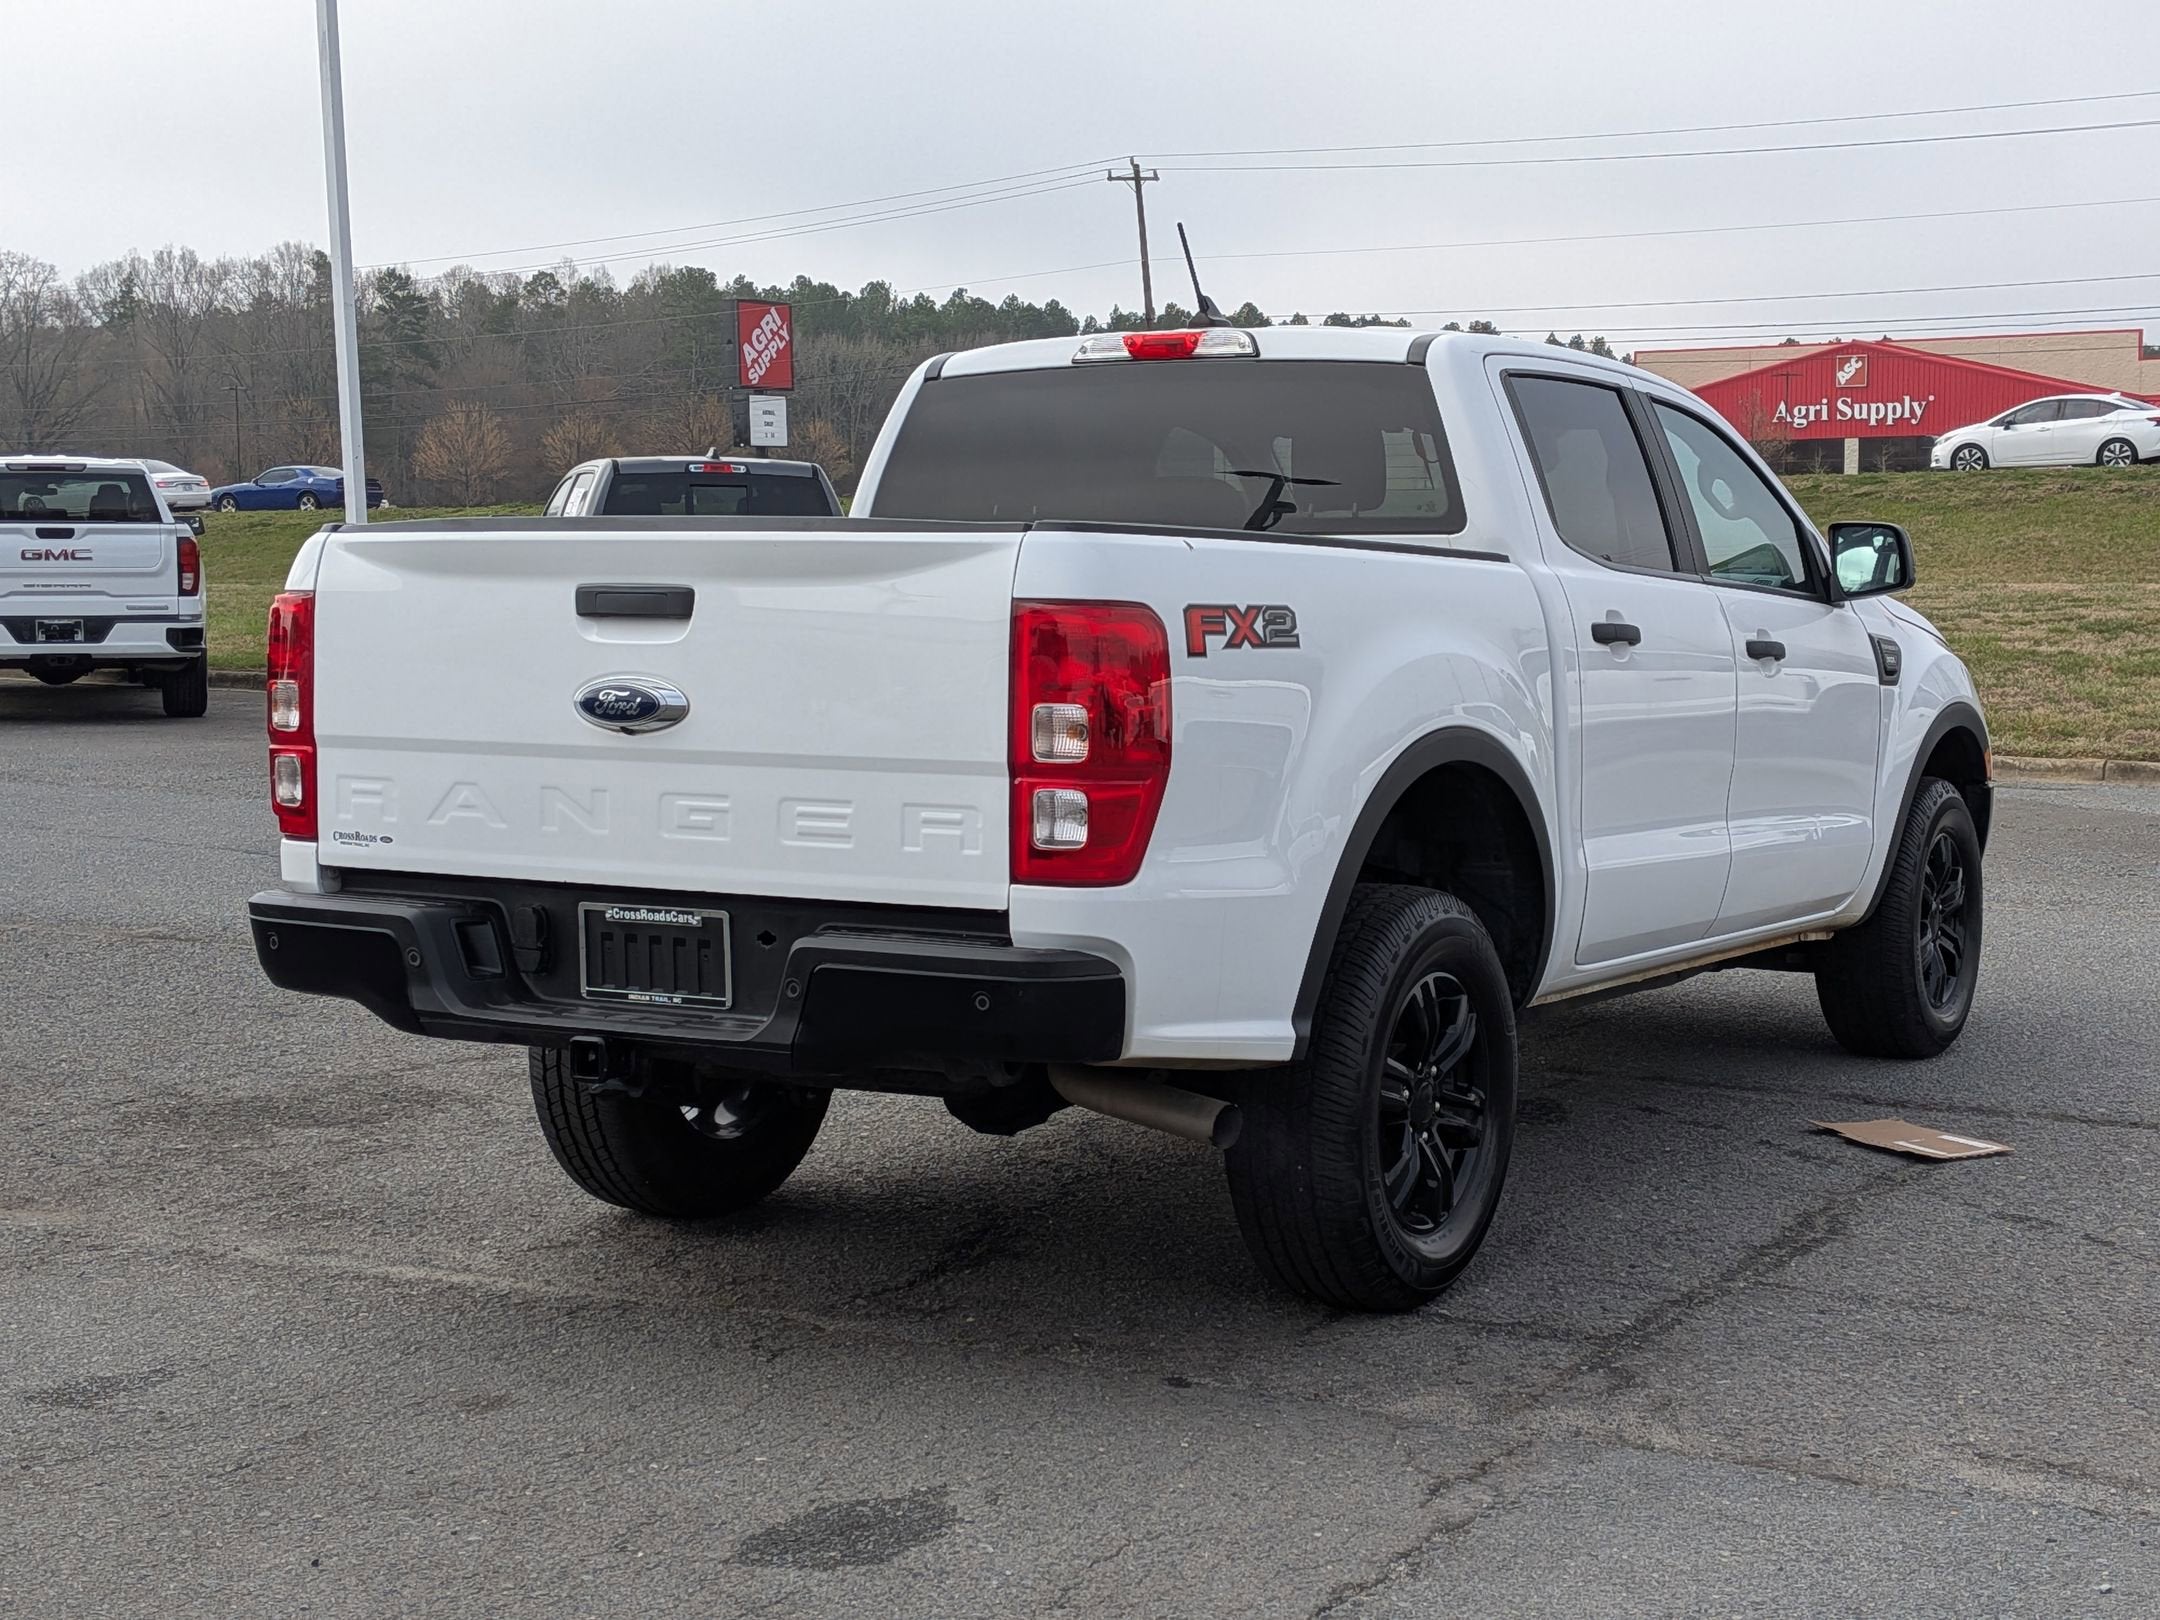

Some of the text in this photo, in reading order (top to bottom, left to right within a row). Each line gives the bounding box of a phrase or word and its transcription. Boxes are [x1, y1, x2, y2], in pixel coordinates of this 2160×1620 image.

[742, 306, 783, 368] AGRI
[748, 322, 791, 385] SUPPLY
[1837, 356, 1863, 385] ASC
[1772, 395, 1926, 428] Agri Supply
[21, 549, 93, 561] GMC
[1183, 603, 1301, 658] FX2
[594, 689, 642, 715] Ford
[335, 774, 983, 855] RANGER
